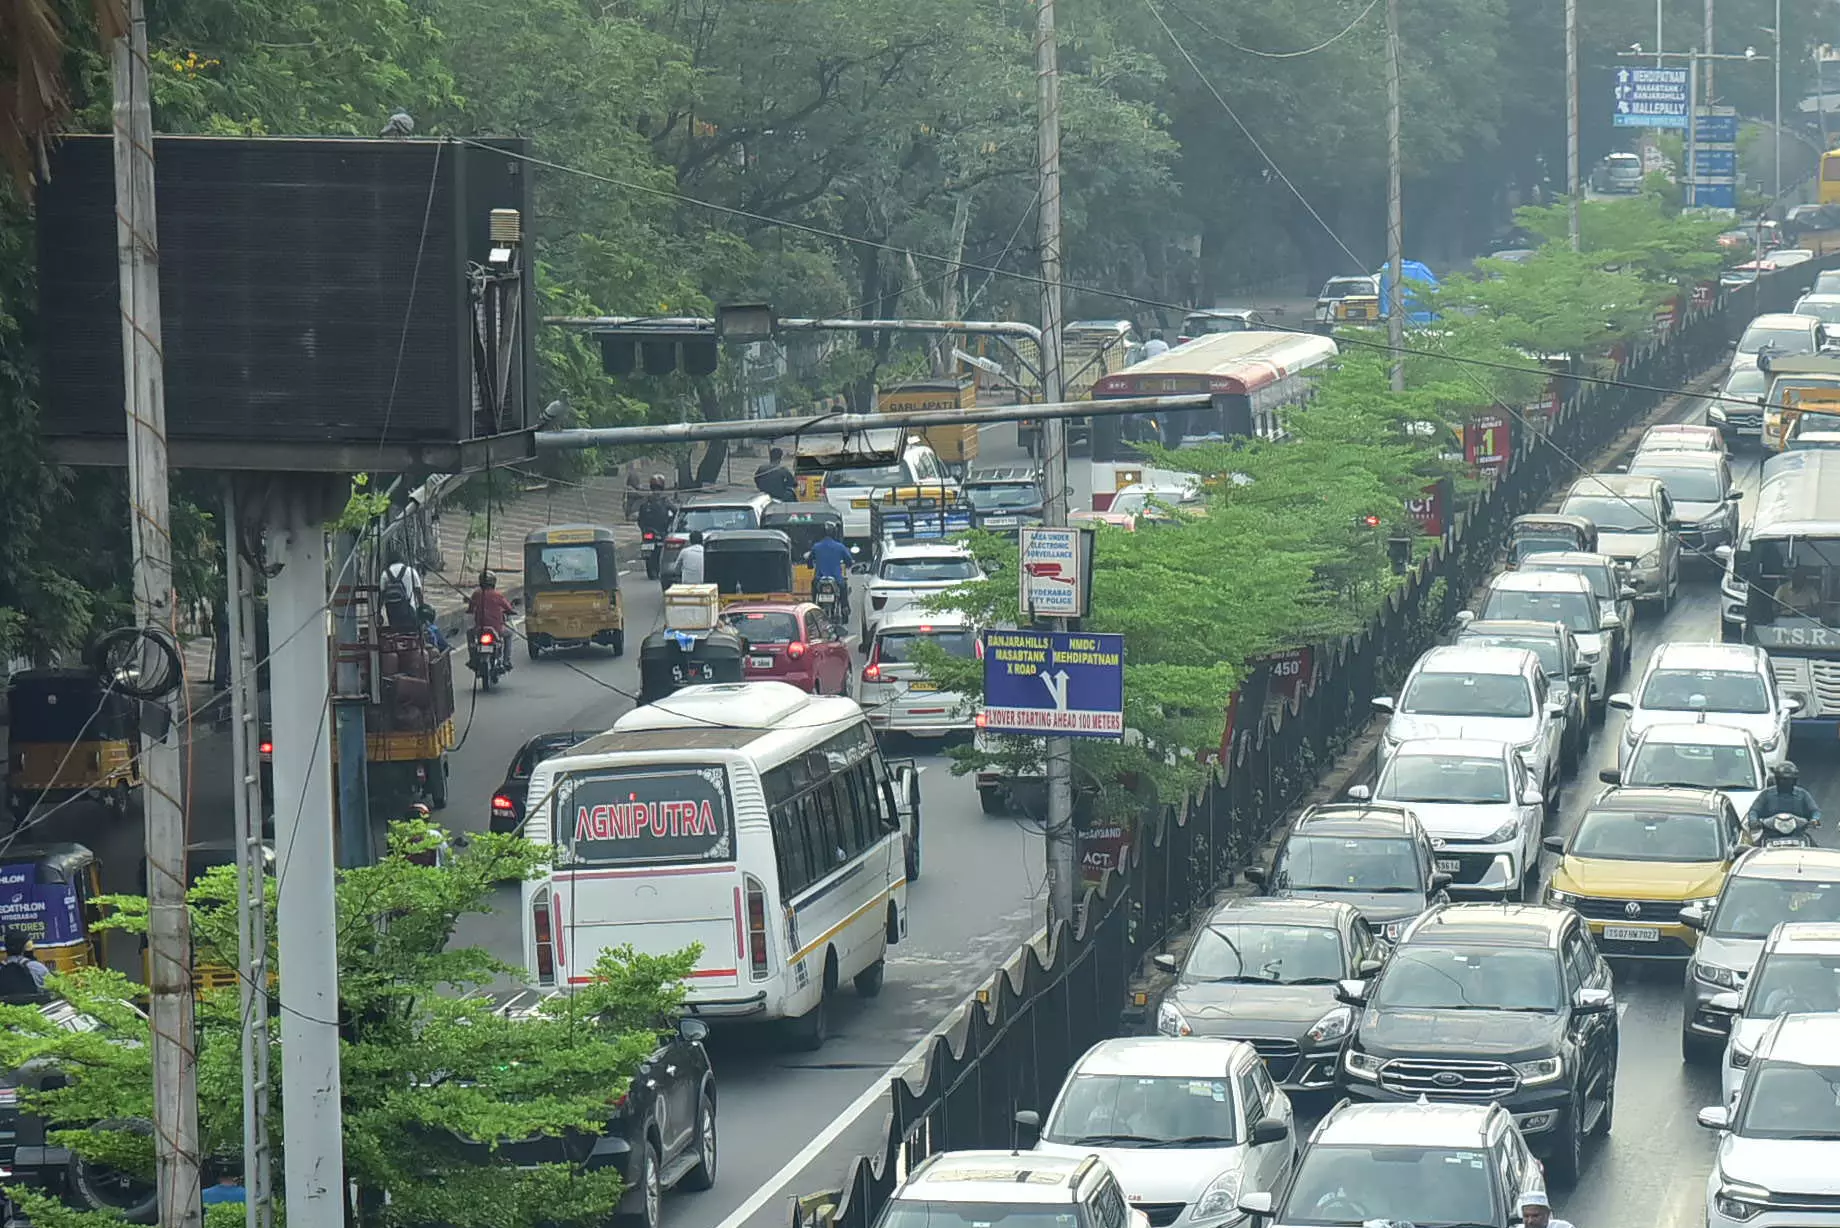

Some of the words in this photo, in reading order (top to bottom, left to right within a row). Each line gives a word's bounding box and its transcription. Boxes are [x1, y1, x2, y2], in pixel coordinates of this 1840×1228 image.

[1633, 70, 1686, 82] MEHDIPATNAM
[1632, 102, 1684, 114] MALLEPALLY
[1069, 638, 1095, 650] NMDC
[995, 650, 1045, 662] MASABTANK
[1054, 652, 1119, 665] MEHDIPATNAM
[1007, 664, 1013, 673] X
[1015, 664, 1036, 675] ROAD
[985, 710, 1015, 725] FLYOVER
[1017, 711, 1051, 727] STARTING
[1053, 714, 1076, 728] AHEAD
[1079, 715, 1090, 728] 100
[1092, 715, 1120, 729] METERS
[575, 800, 717, 841] AGNIPUTRA
[1083, 851, 1110, 866] ACT
